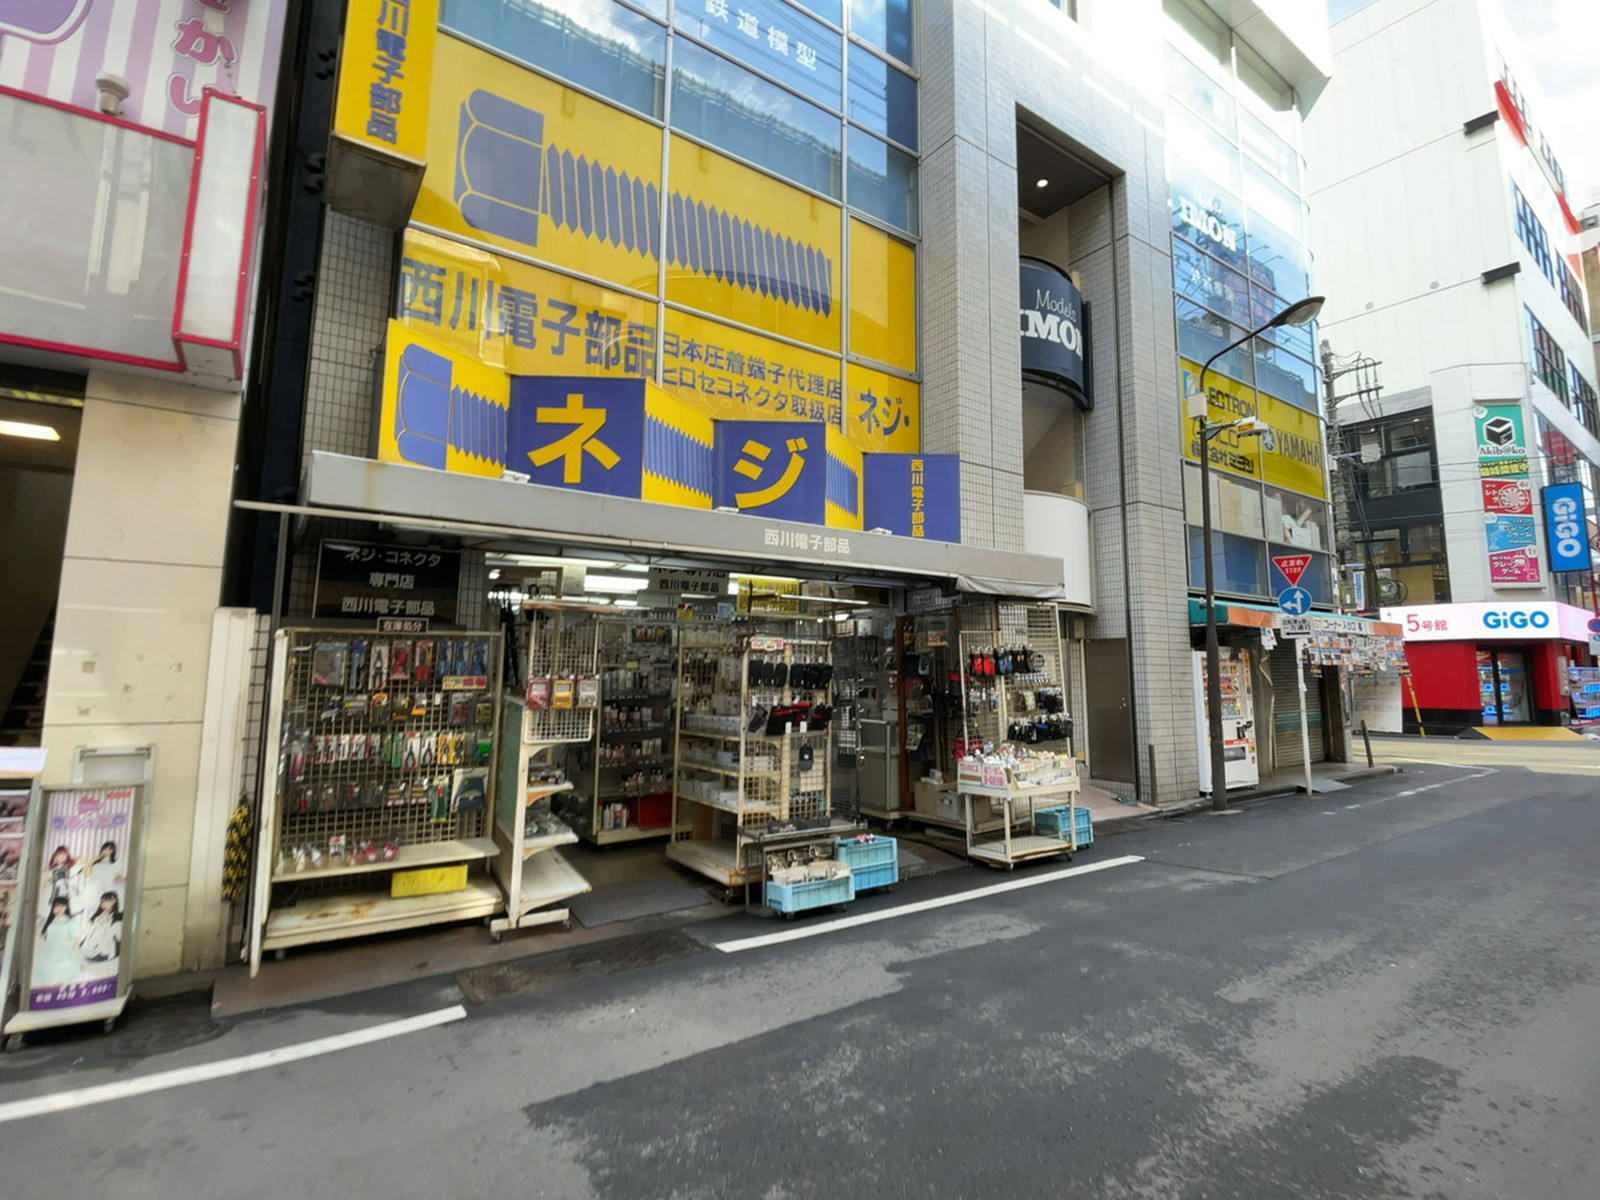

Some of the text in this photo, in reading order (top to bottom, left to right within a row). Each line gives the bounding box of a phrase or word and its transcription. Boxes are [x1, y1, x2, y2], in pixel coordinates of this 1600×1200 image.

[367, 0, 411, 145] 川電子部品
[402, 257, 657, 378] 西川電子部品
[663, 331, 842, 399] 日本圧着端子代理店
[1276, 429, 1322, 468] YAMAHA
[910, 459, 924, 538] 西川電子部品
[1553, 497, 1581, 558] GiGO
[764, 528, 851, 554] 西川電子部品
[345, 548, 442, 568] ネジ・コネクタ
[1280, 559, 1304, 567] 止まれ
[369, 572, 415, 590] 専門店
[659, 579, 720, 593] 西川電子部品
[341, 597, 435, 616] 西川電子部品
[383, 620, 422, 632] 在庫処分
[1406, 613, 1448, 632] 5号館
[1482, 611, 1549, 629] GiGO
